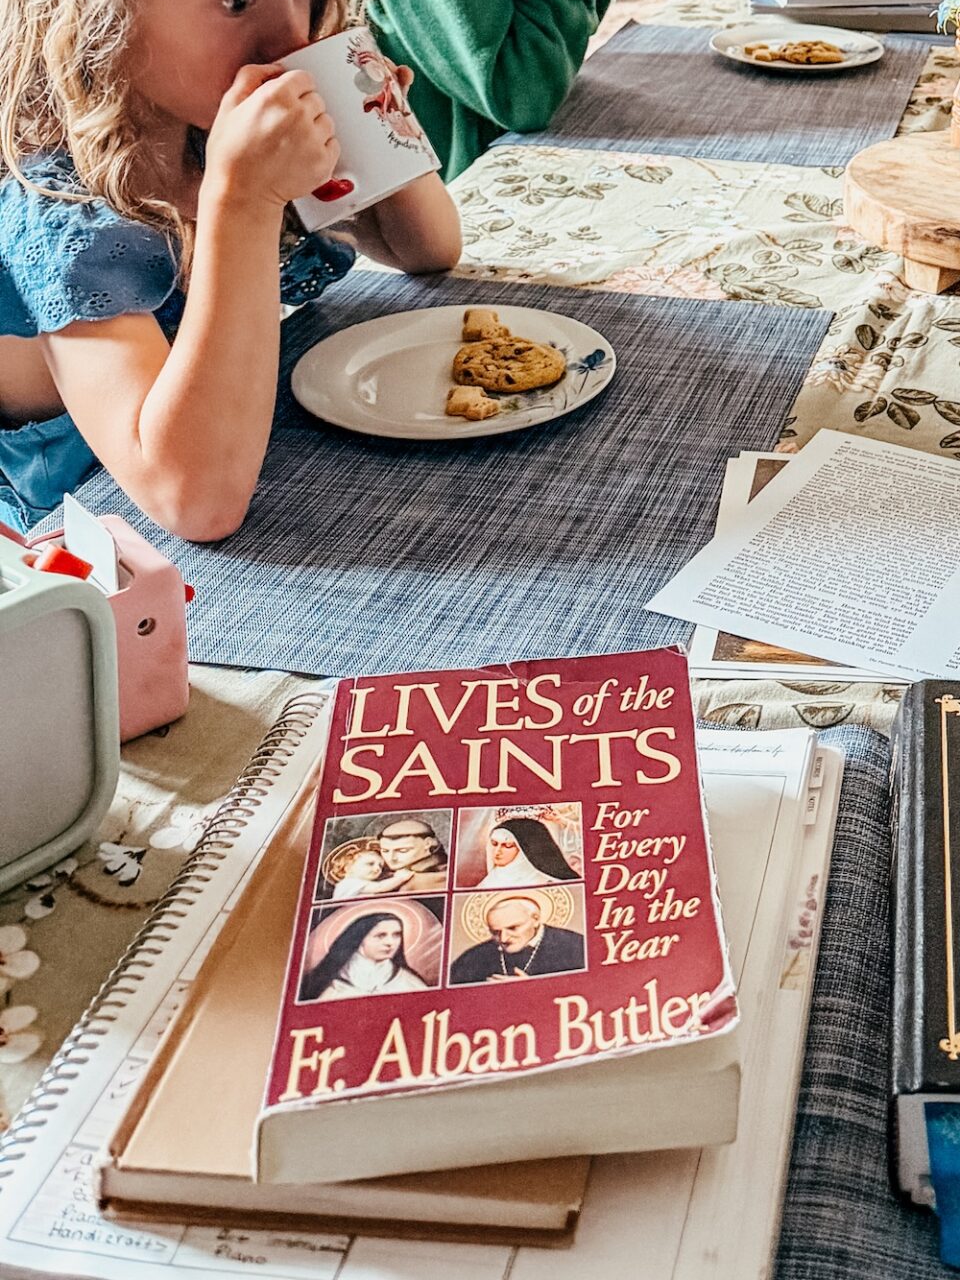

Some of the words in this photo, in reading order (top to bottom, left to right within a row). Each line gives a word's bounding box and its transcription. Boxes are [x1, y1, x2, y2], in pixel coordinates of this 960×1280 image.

[341, 673, 564, 740] LIVES
[572, 677, 618, 726] of
[619, 675, 675, 711] the
[332, 727, 682, 804] SAINTS
[590, 801, 650, 831] For
[591, 831, 687, 864] Every
[593, 863, 667, 900] Day
[594, 897, 636, 930] In
[647, 888, 701, 923] the
[601, 929, 679, 966] Year
[278, 1026, 346, 1102] Fr.
[362, 1008, 541, 1089] Alban
[552, 978, 711, 1061] Butler
